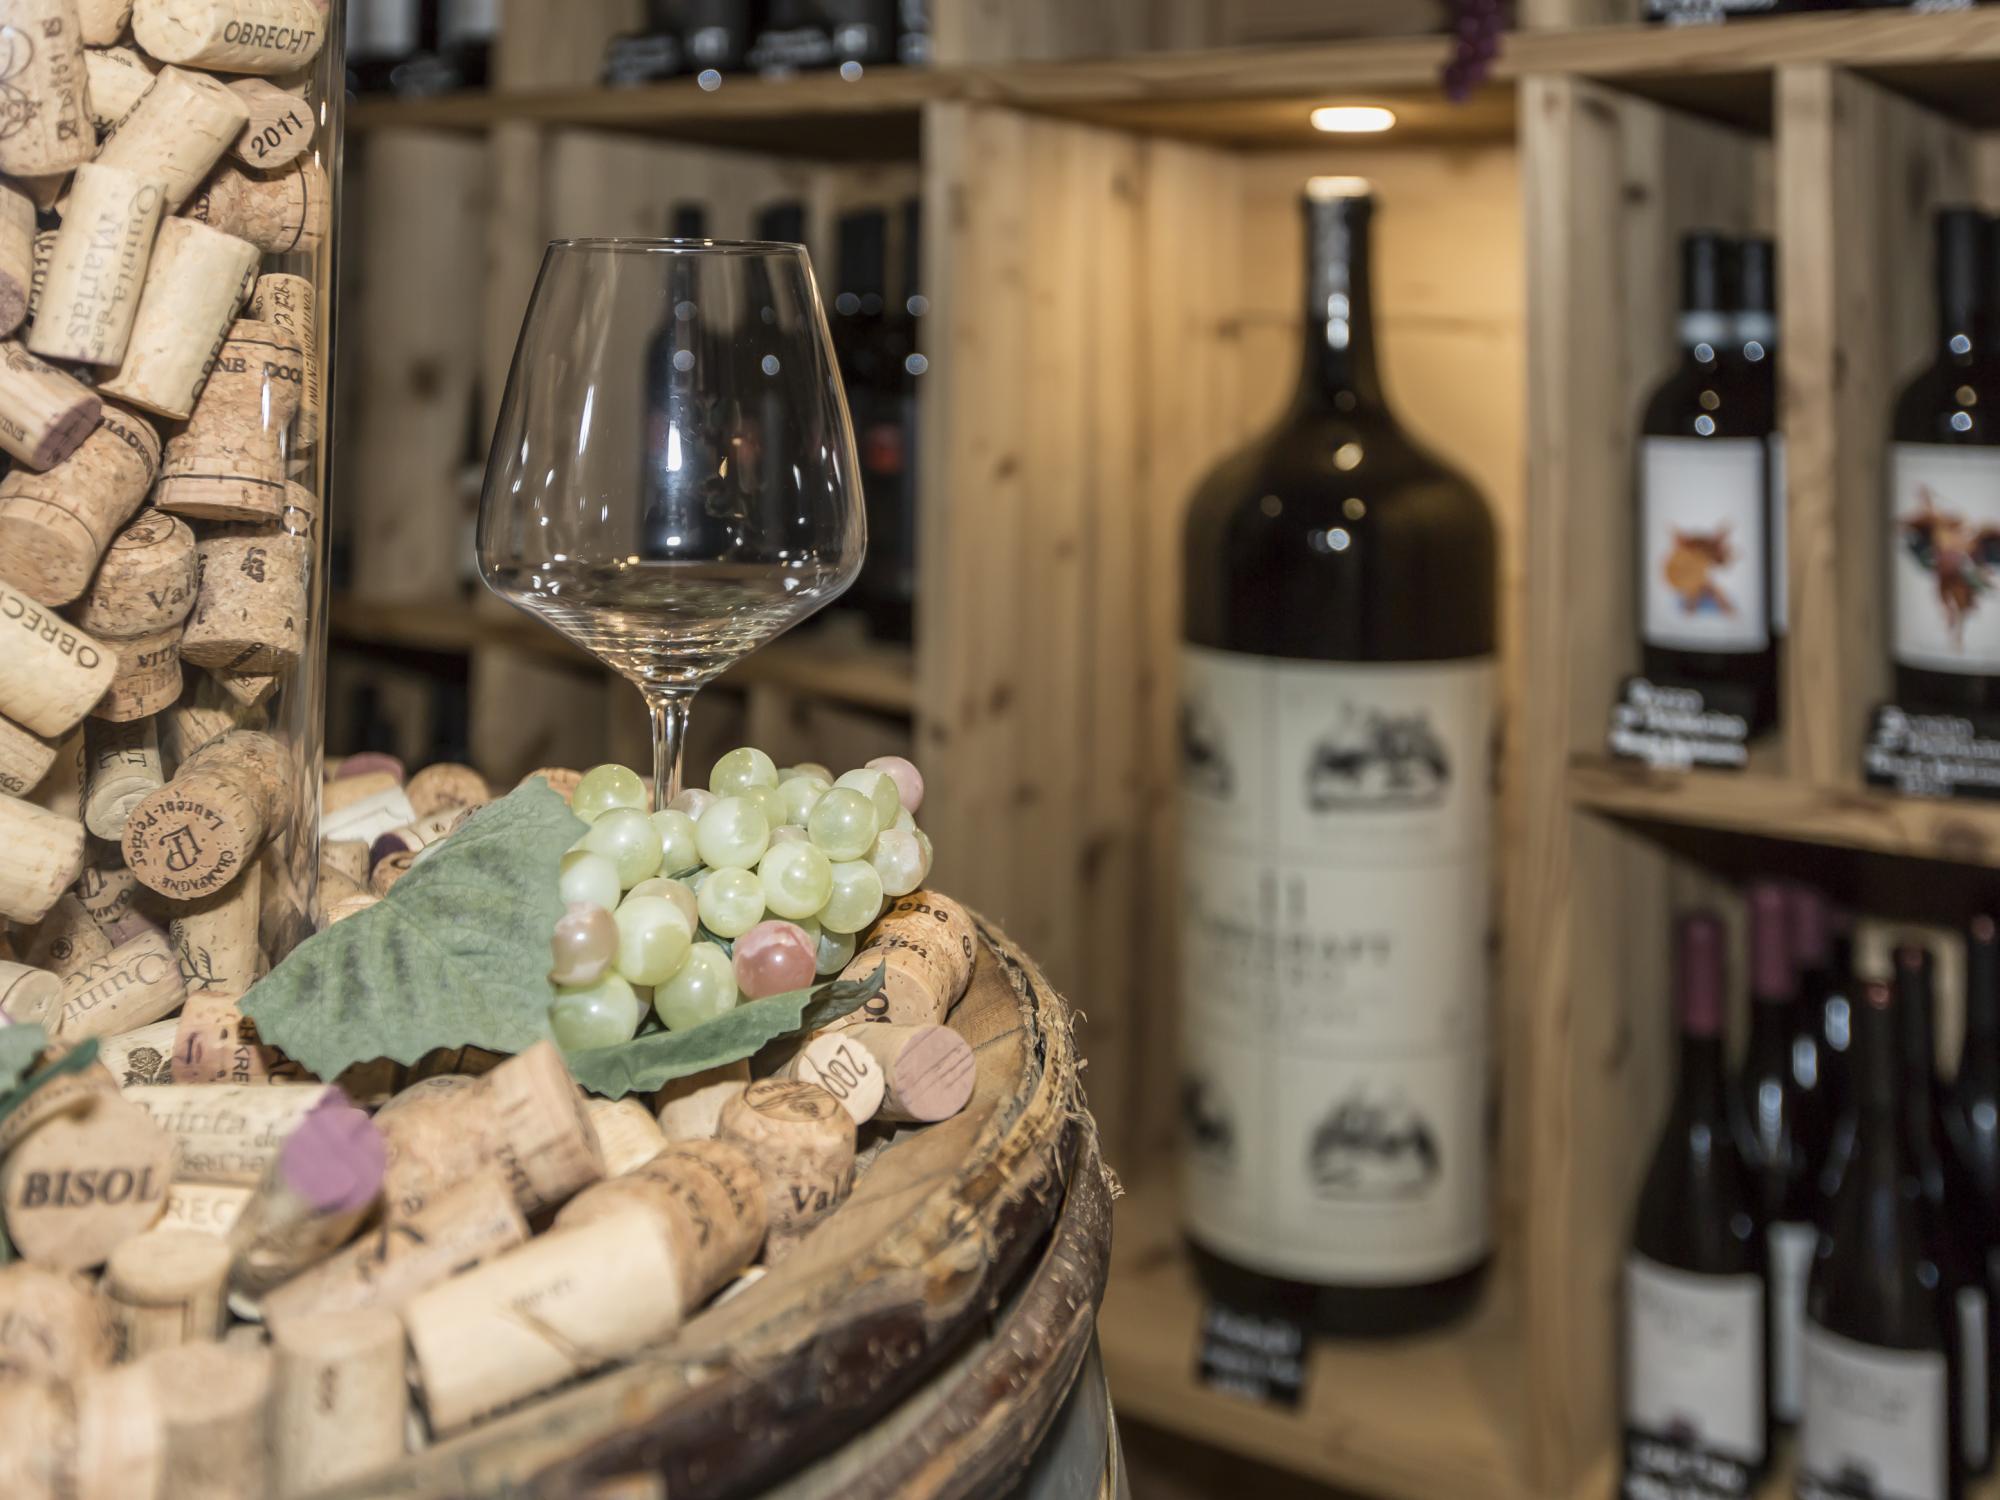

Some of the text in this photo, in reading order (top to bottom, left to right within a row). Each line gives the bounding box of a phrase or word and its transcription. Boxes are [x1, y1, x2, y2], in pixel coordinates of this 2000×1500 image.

[223, 20, 316, 54] OBRECHT
[250, 110, 305, 160] 2011
[0, 588, 99, 669] OBREC
[130, 799, 225, 867] Laurent-Perrier
[161, 849, 234, 892] CHAMPAGNE
[233, 1046, 250, 1085] KRE
[21, 1166, 160, 1209] BISOL
